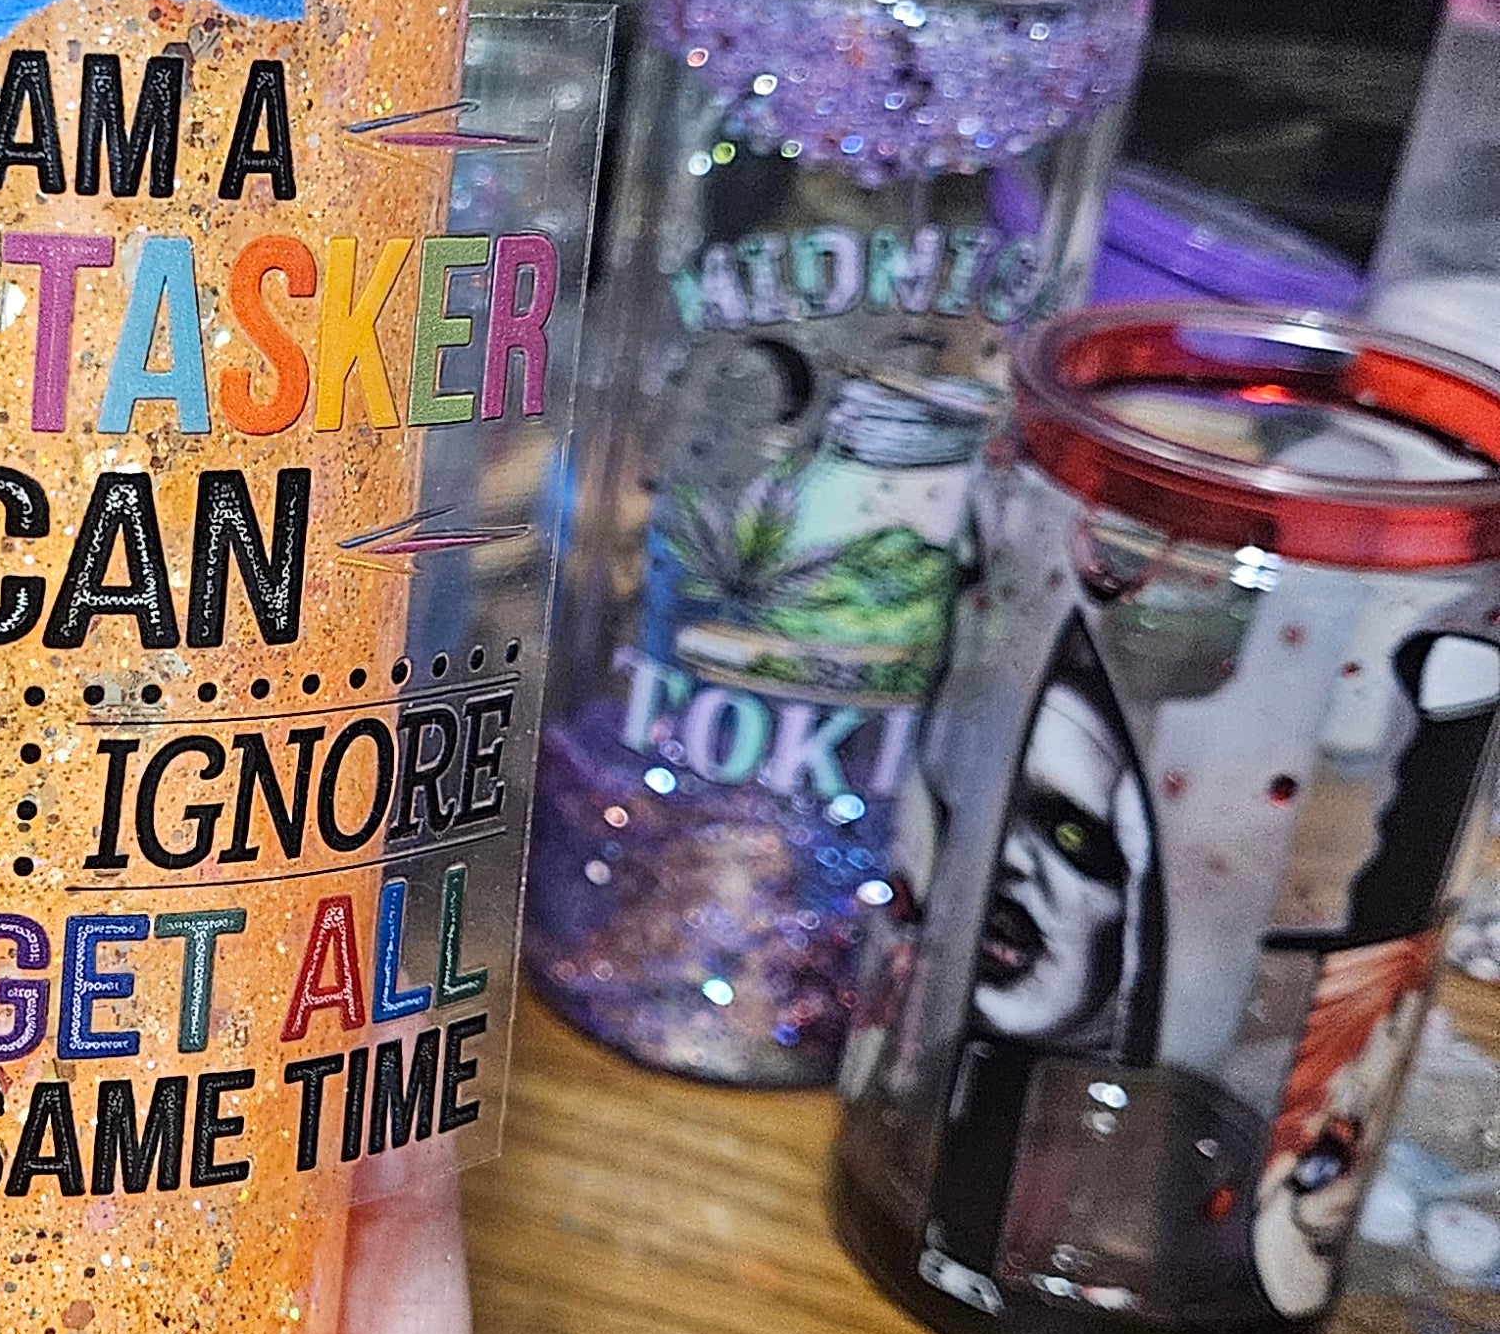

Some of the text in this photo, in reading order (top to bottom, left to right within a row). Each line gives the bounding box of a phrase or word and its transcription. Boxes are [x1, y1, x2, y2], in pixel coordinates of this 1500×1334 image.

[218, 59, 297, 201] A
[83, 690, 515, 870] IGNORE
[279, 864, 488, 1043] ALL
[284, 1012, 488, 1172] TIME
